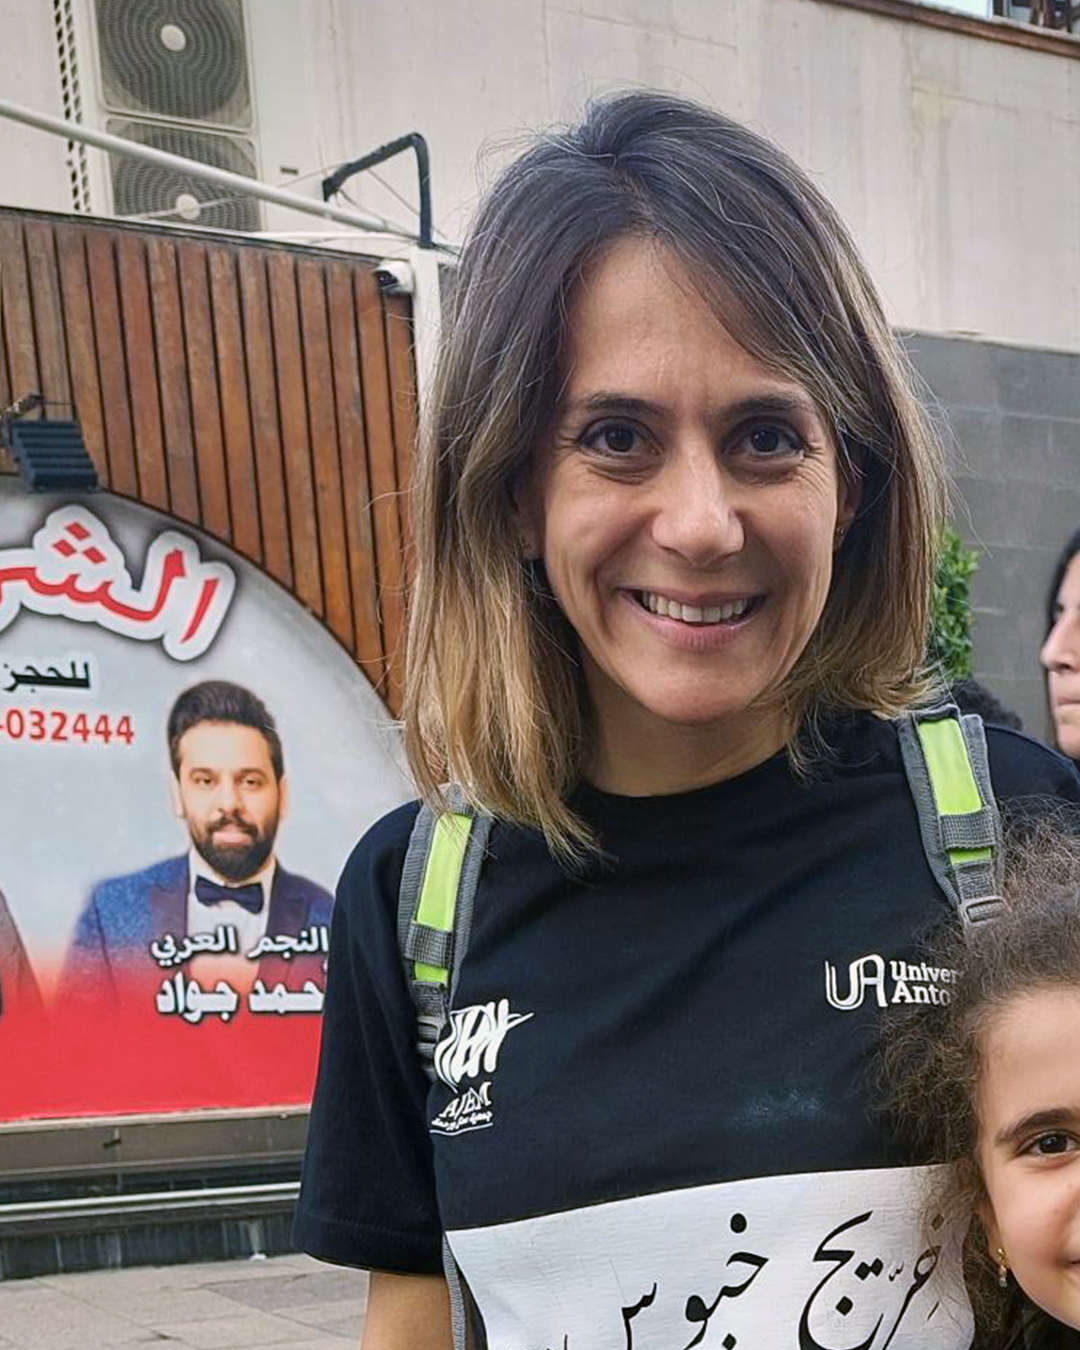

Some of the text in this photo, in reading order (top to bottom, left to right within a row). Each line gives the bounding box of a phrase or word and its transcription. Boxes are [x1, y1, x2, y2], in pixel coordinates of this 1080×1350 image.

[0, 522, 219, 643] الش
[3, 660, 90, 693] للحجز
[0, 709, 134, 744] 032444
[151, 925, 328, 966] النجم العربي
[889, 960, 963, 984] Univer
[156, 971, 326, 1023] حمد جواد
[891, 980, 951, 1006] Anto
